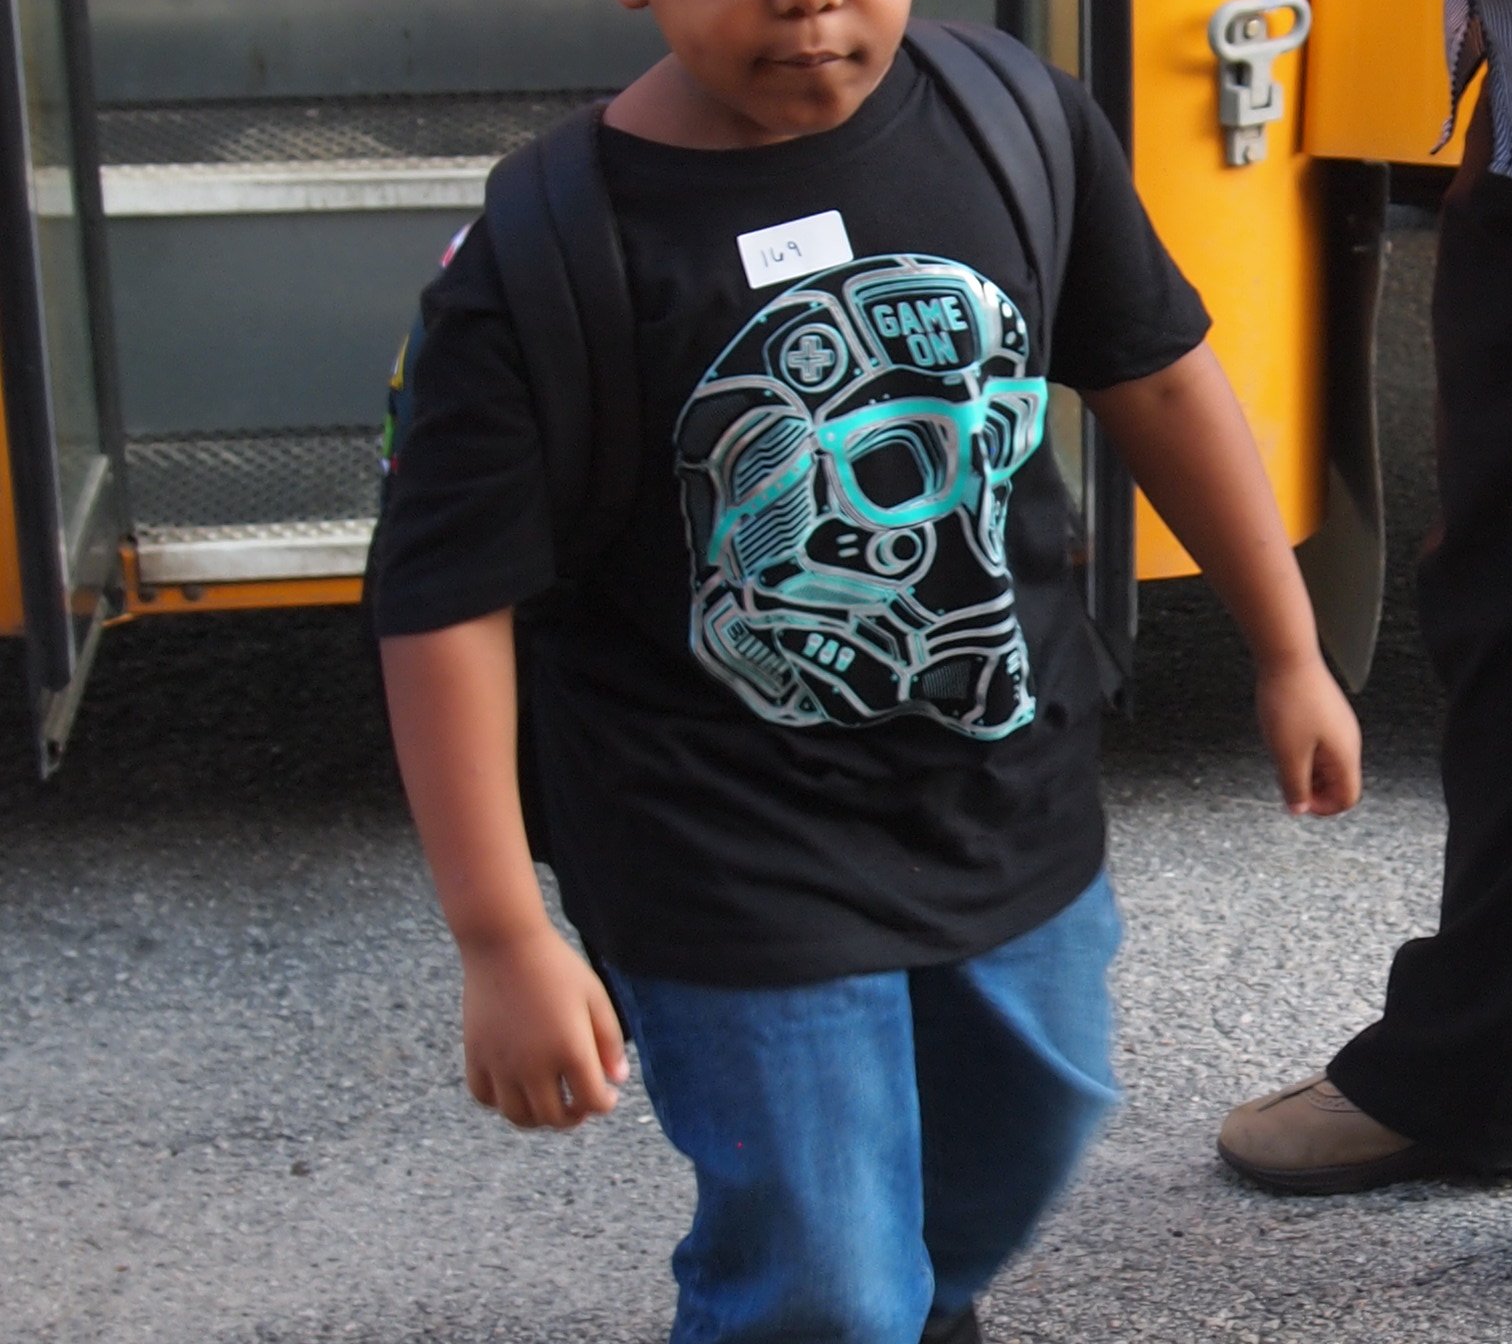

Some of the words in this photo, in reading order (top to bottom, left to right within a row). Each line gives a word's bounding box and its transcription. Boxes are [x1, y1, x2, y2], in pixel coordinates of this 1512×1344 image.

[759, 240, 803, 269] 169
[871, 295, 968, 339] GAME
[906, 333, 960, 368] ON
